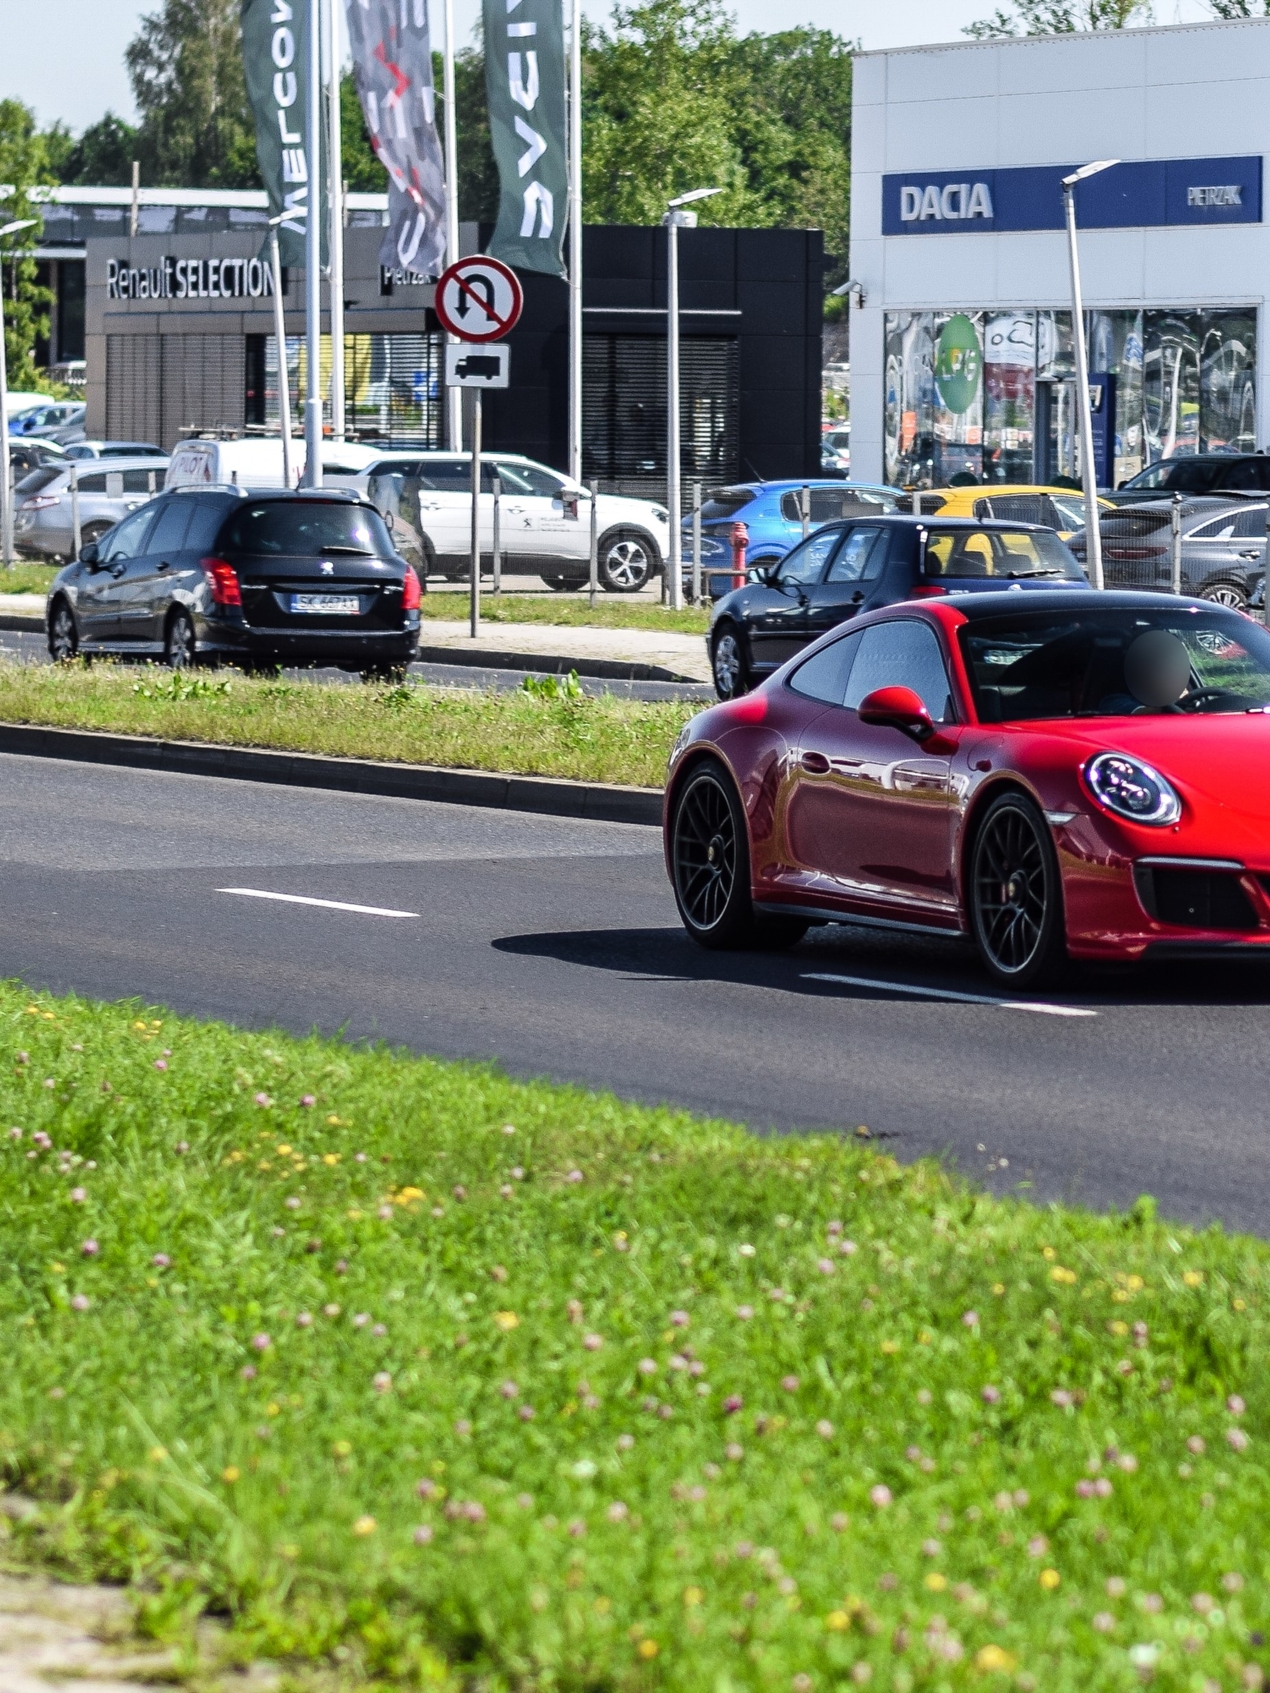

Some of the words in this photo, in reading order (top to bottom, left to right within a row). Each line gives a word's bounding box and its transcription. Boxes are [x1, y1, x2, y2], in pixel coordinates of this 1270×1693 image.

[901, 183, 994, 221] DACIA
[1187, 185, 1243, 207] PIETRZAK
[106, 256, 173, 299] Renault
[175, 257, 277, 298] SELECTION
